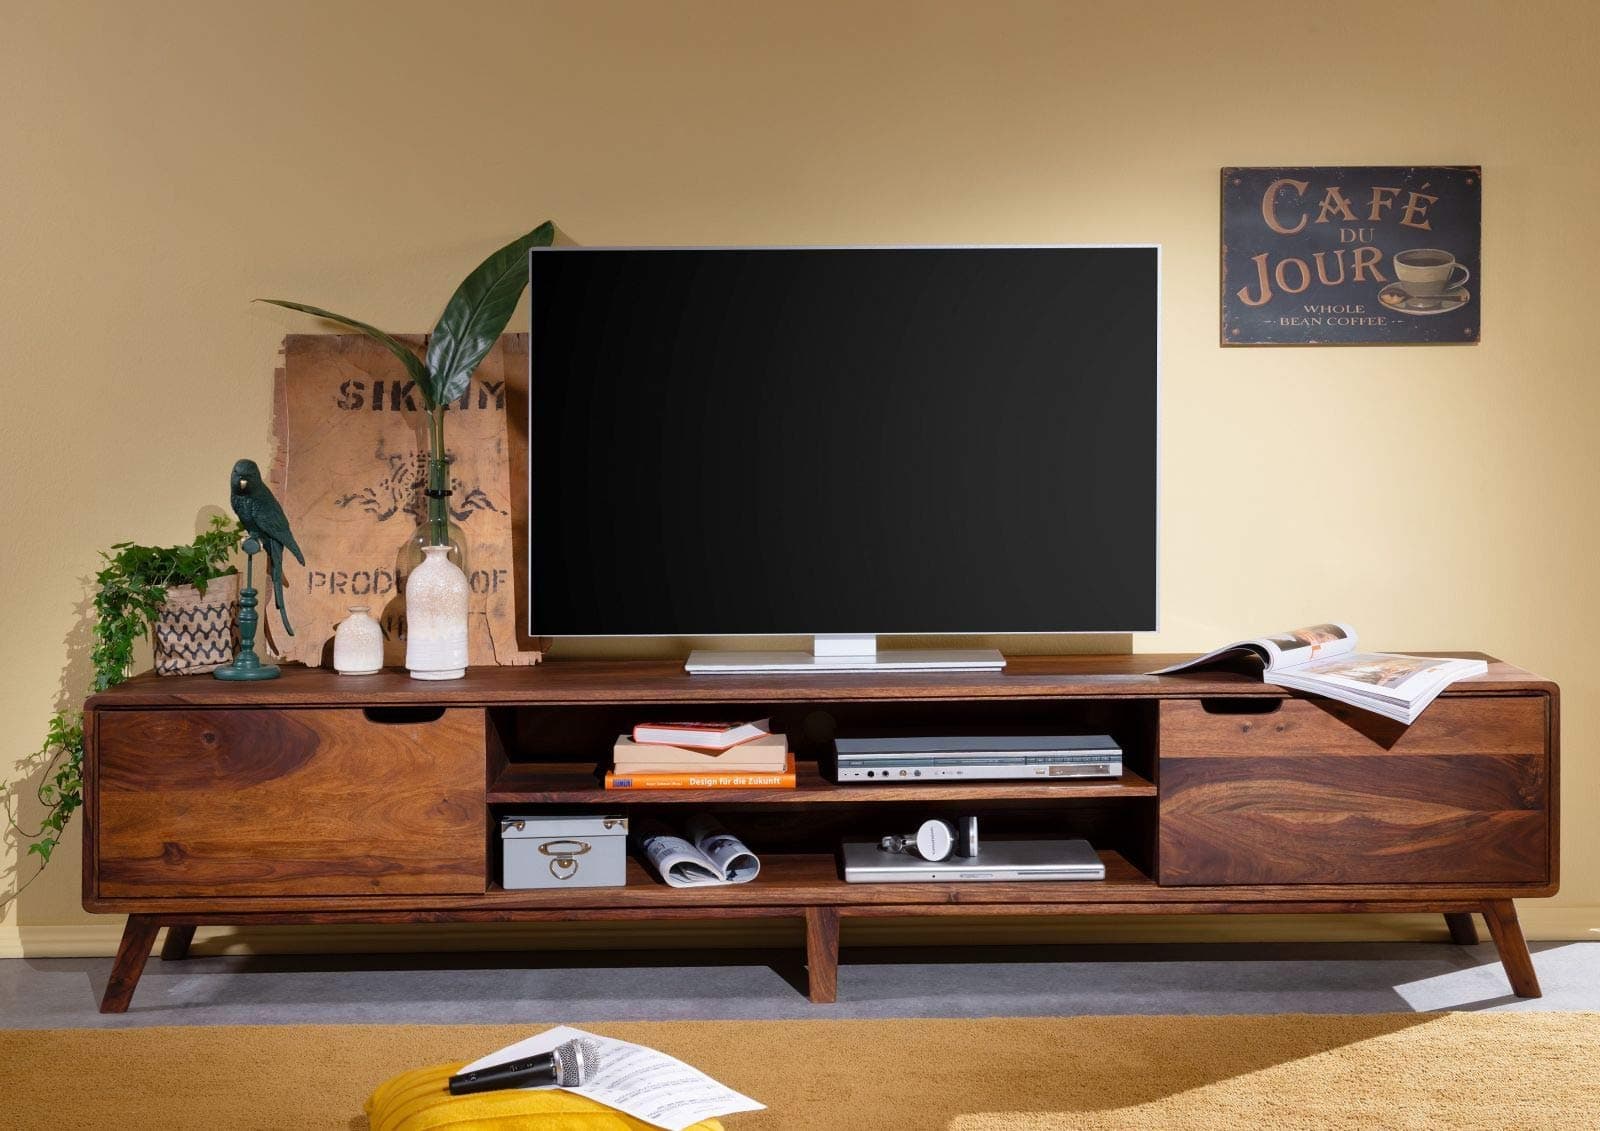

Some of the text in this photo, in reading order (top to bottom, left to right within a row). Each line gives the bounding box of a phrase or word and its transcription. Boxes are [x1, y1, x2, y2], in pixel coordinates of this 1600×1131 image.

[1262, 178, 1439, 236] CAFÉ
[1340, 228, 1375, 243] DU
[1236, 246, 1387, 307] JOUR
[1303, 304, 1366, 314] WHOLE
[1279, 316, 1387, 326] BEAN COFFEE
[336, 379, 505, 411] SIKIM
[470, 568, 508, 593] OF
[689, 777, 717, 787] Design
[719, 776, 731, 785] für
[733, 776, 746, 785] die
[748, 777, 781, 785] Zukunft
